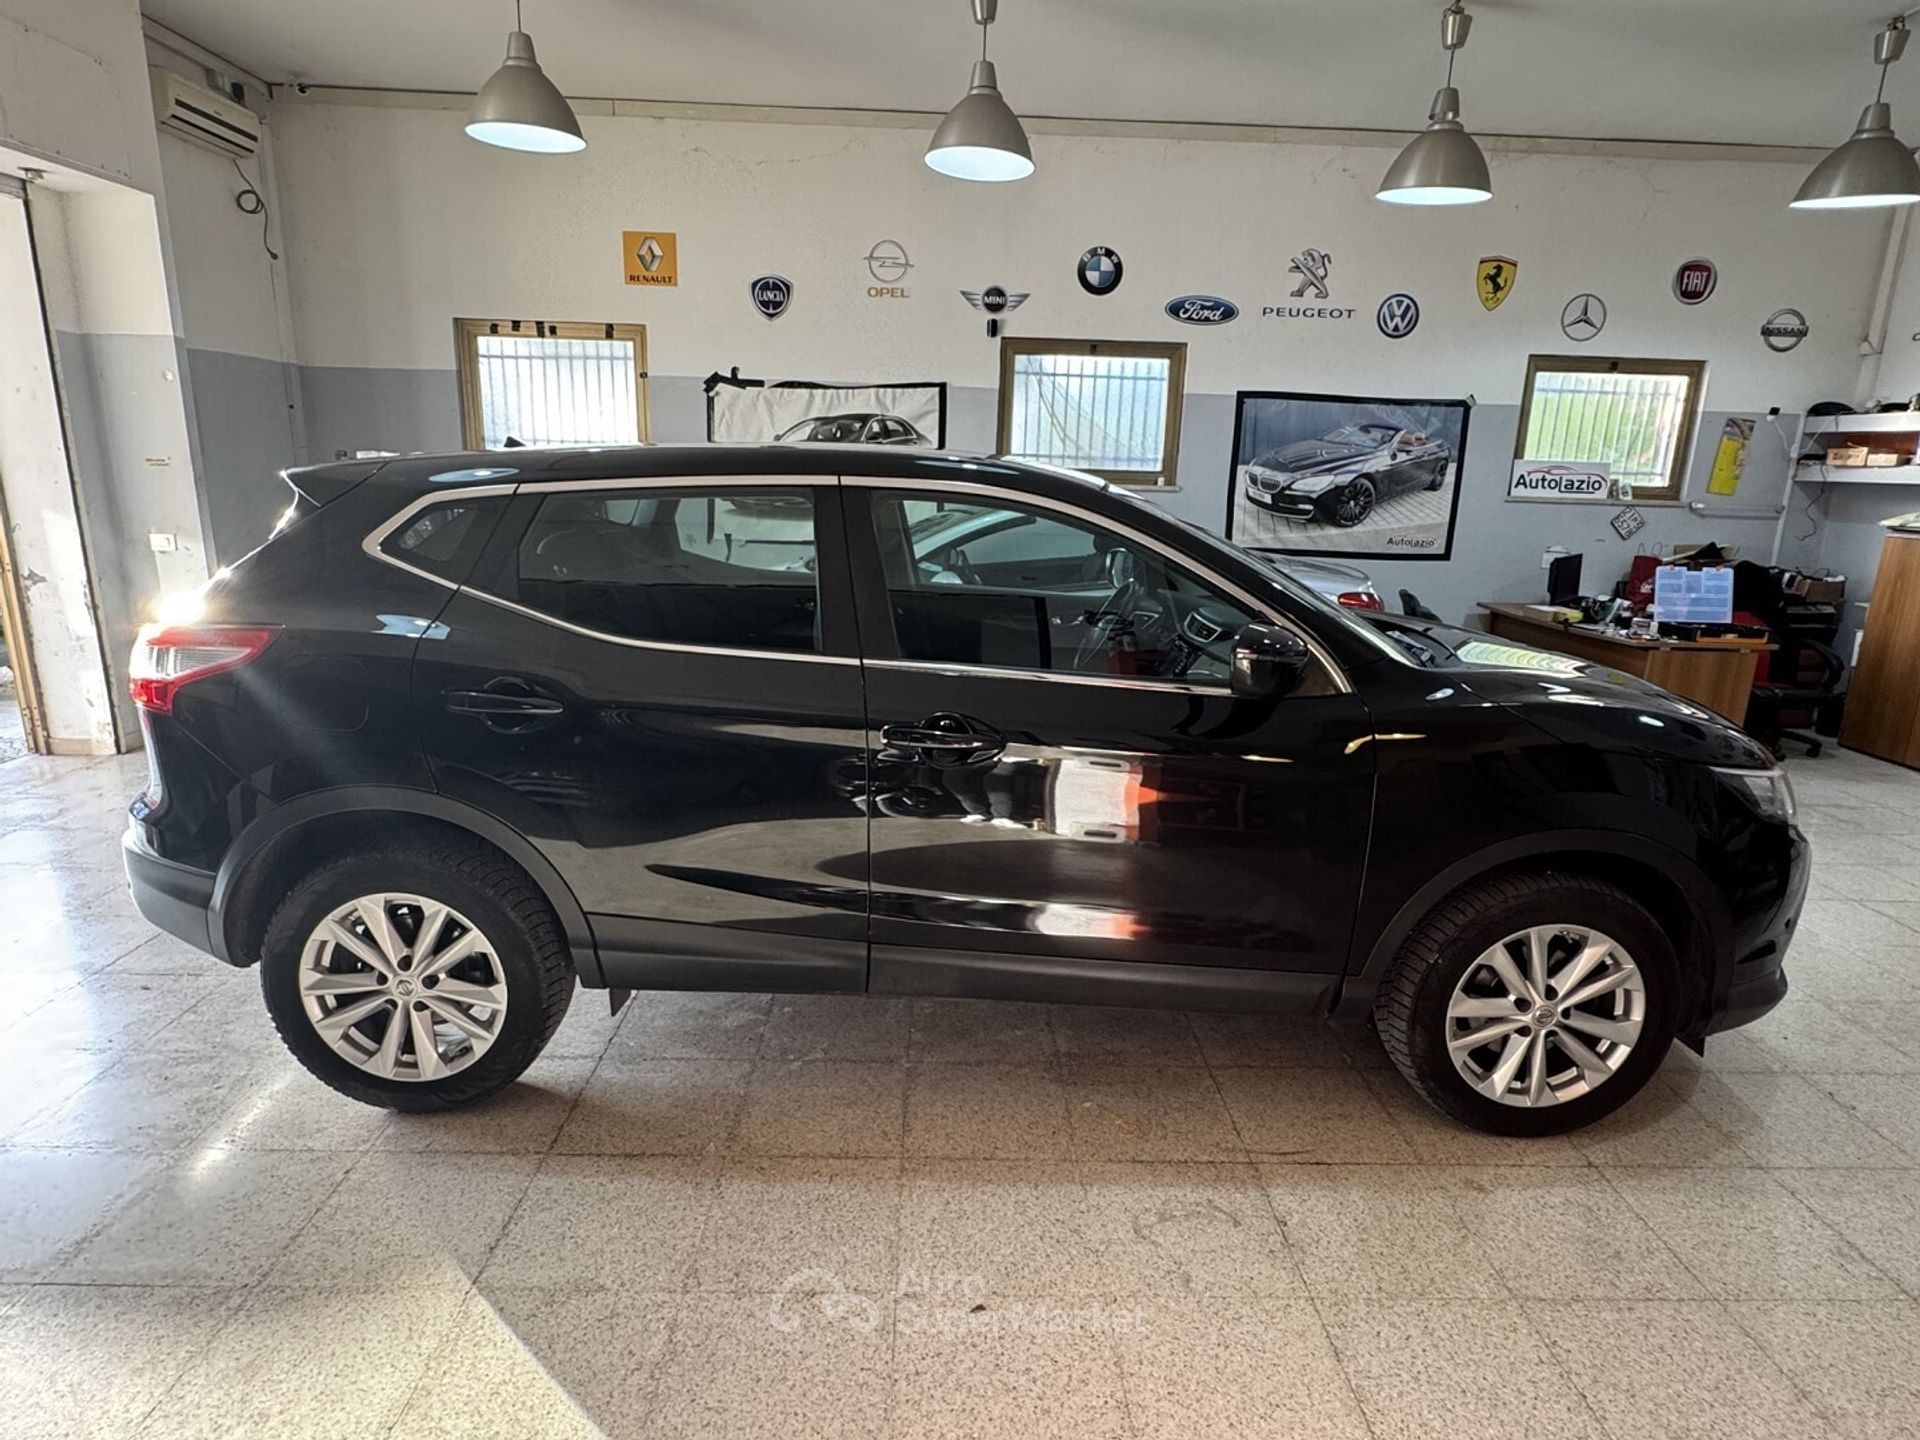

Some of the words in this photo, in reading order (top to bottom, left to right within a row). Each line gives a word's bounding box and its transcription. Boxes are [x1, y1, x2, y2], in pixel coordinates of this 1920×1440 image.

[629, 274, 672, 284] RENAULT
[1681, 270, 1709, 292] FIAT
[758, 289, 784, 302] LANCIA
[867, 286, 910, 298] OPEL
[983, 295, 1006, 305] MINI
[1179, 299, 1225, 321] Ford
[1262, 306, 1357, 319] PEUGEOT
[1765, 326, 1804, 335] NISSAN
